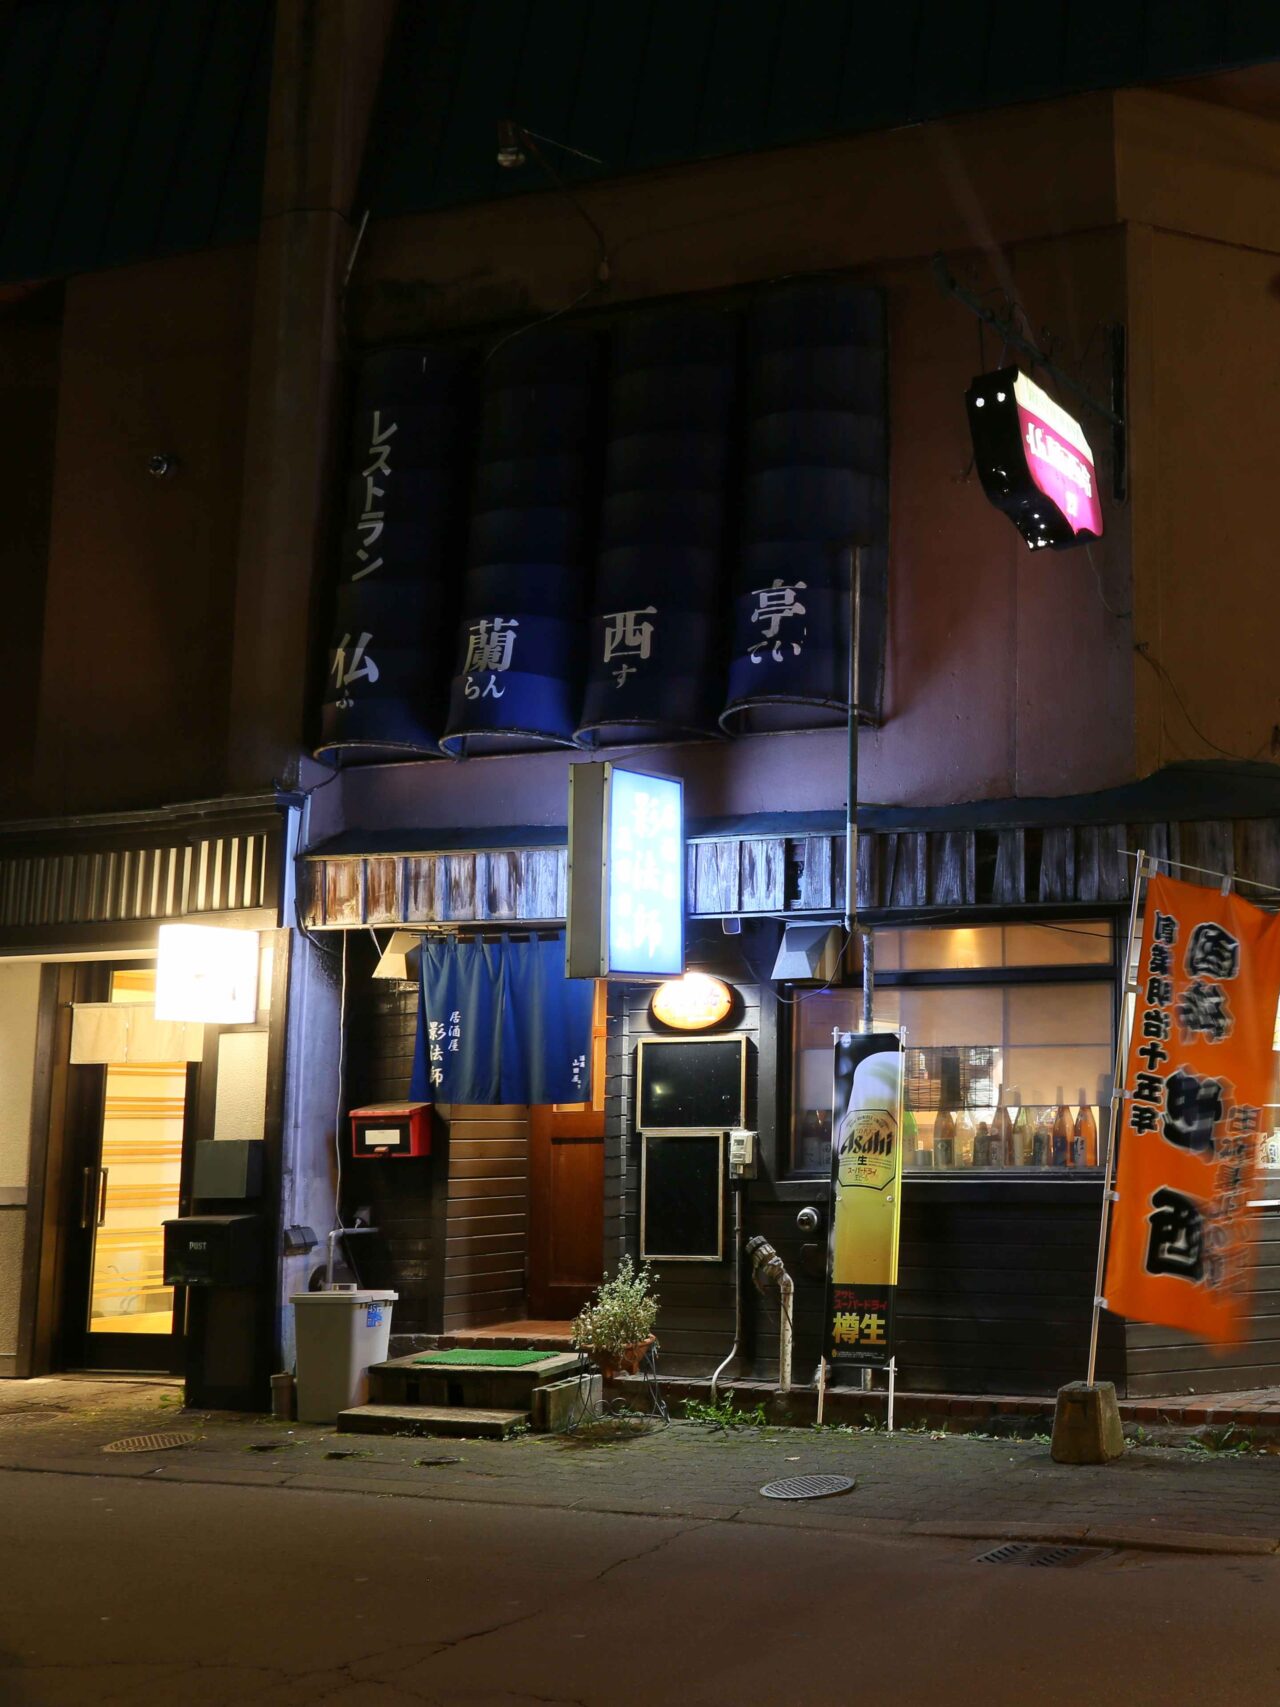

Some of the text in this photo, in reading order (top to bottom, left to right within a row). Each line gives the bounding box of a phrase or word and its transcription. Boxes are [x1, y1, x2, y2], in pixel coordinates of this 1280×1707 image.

[351, 411, 398, 581] レストラン
[330, 578, 808, 690] 仏 蘭 西 亭
[463, 676, 506, 699] らん
[612, 664, 638, 689] す
[448, 1011, 461, 1052] 居酒屋
[428, 1021, 447, 1088] 影法師
[840, 1129, 893, 1157] Asahi
[857, 1155, 868, 1166] 生
[189, 1241, 207, 1250] POST
[832, 1311, 887, 1345] 樽生
